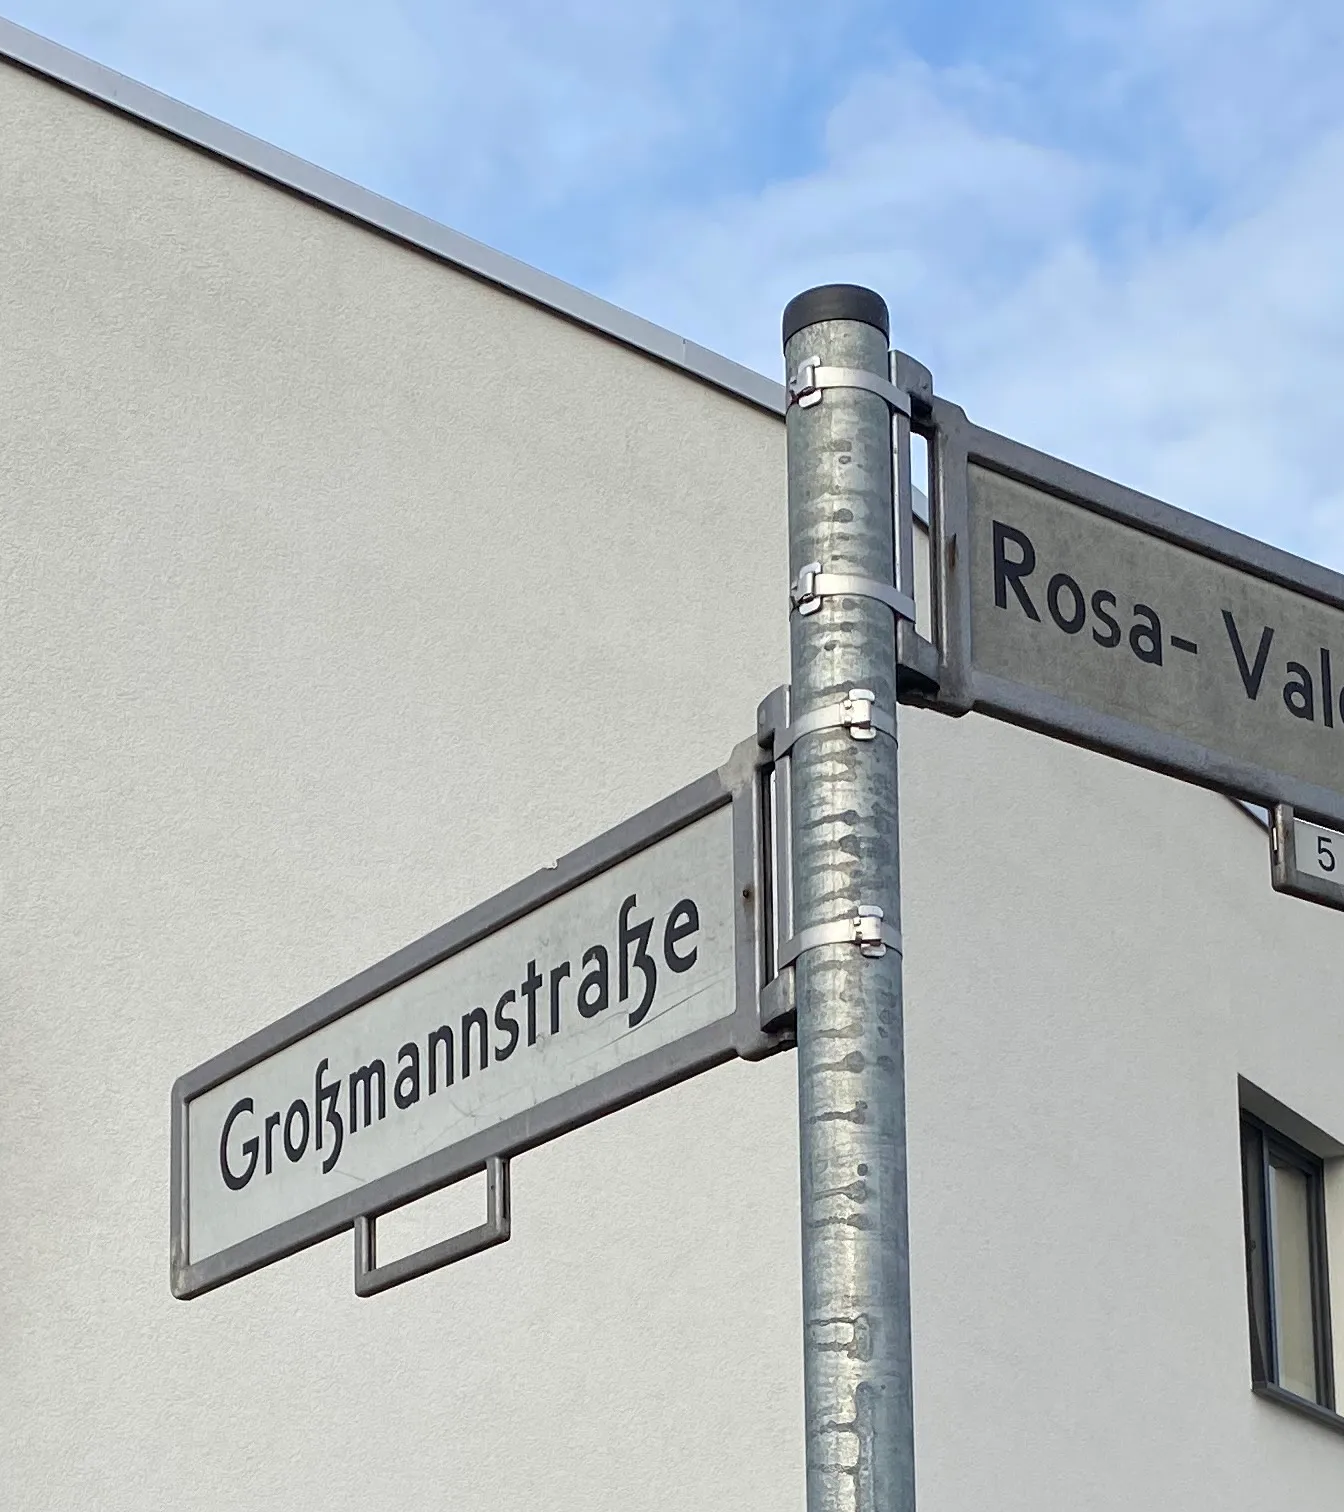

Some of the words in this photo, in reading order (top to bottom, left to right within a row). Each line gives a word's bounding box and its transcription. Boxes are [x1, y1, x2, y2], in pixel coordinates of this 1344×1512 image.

[993, 520, 1197, 666] Rosa-
[1317, 836, 1335, 872] 5
[220, 894, 699, 1190] Großmannstraße
